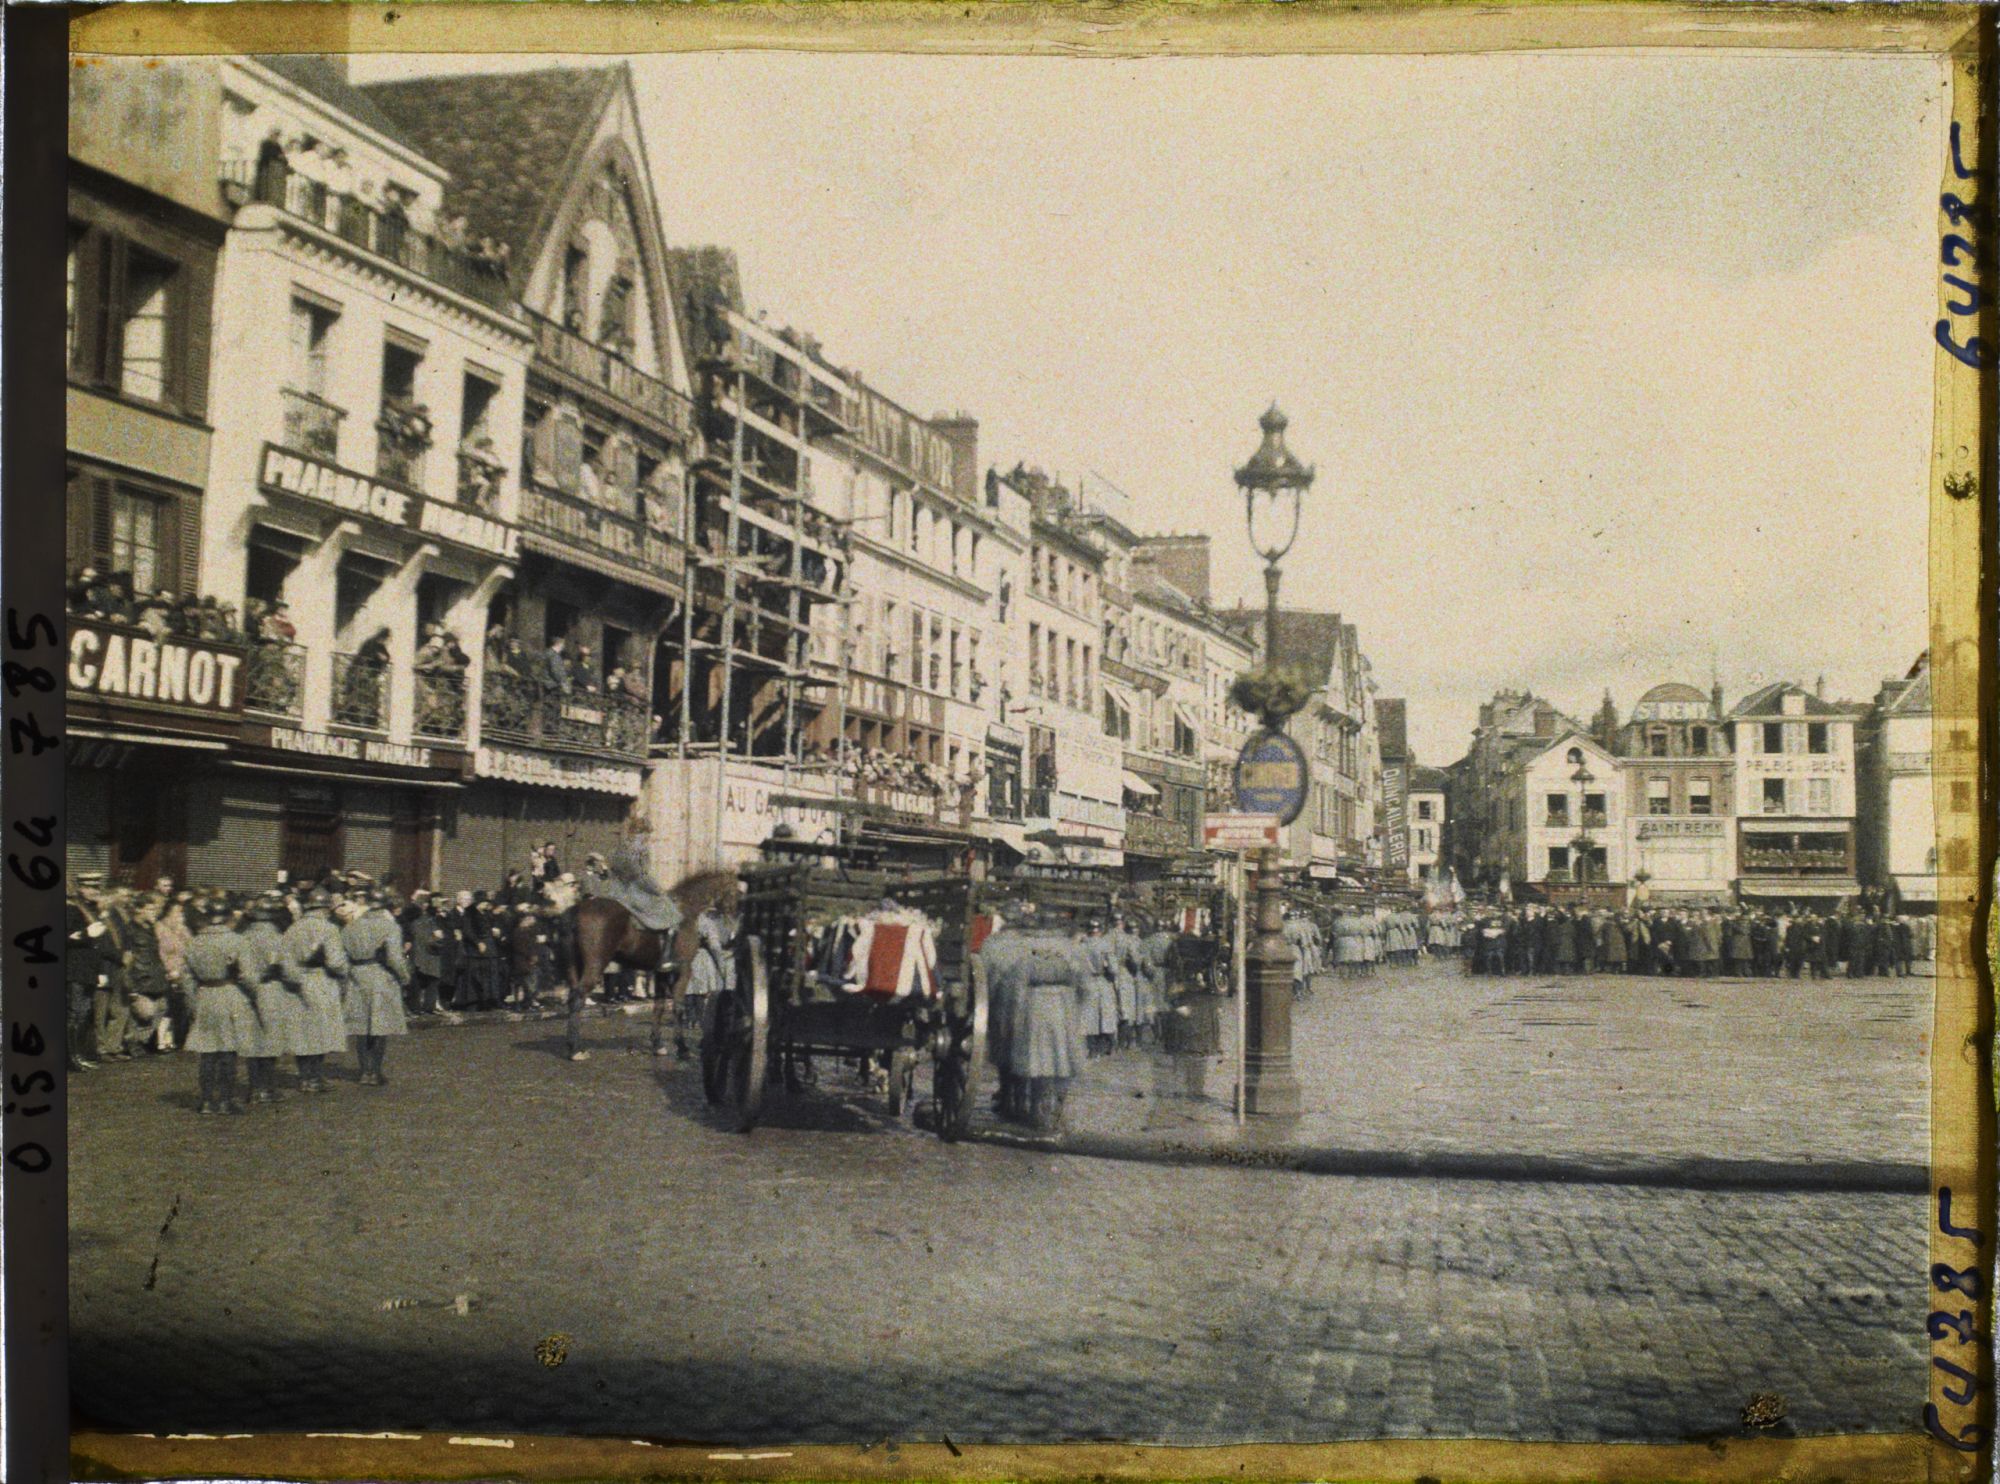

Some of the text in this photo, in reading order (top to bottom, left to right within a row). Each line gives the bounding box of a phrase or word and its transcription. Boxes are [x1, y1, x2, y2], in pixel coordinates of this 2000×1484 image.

[69, 629, 241, 708] CARNOT
[271, 727, 431, 768] PHARMACIE NORMALE
[725, 785, 746, 812] AU
[1383, 768, 1408, 864] QUINCAILLERIE
